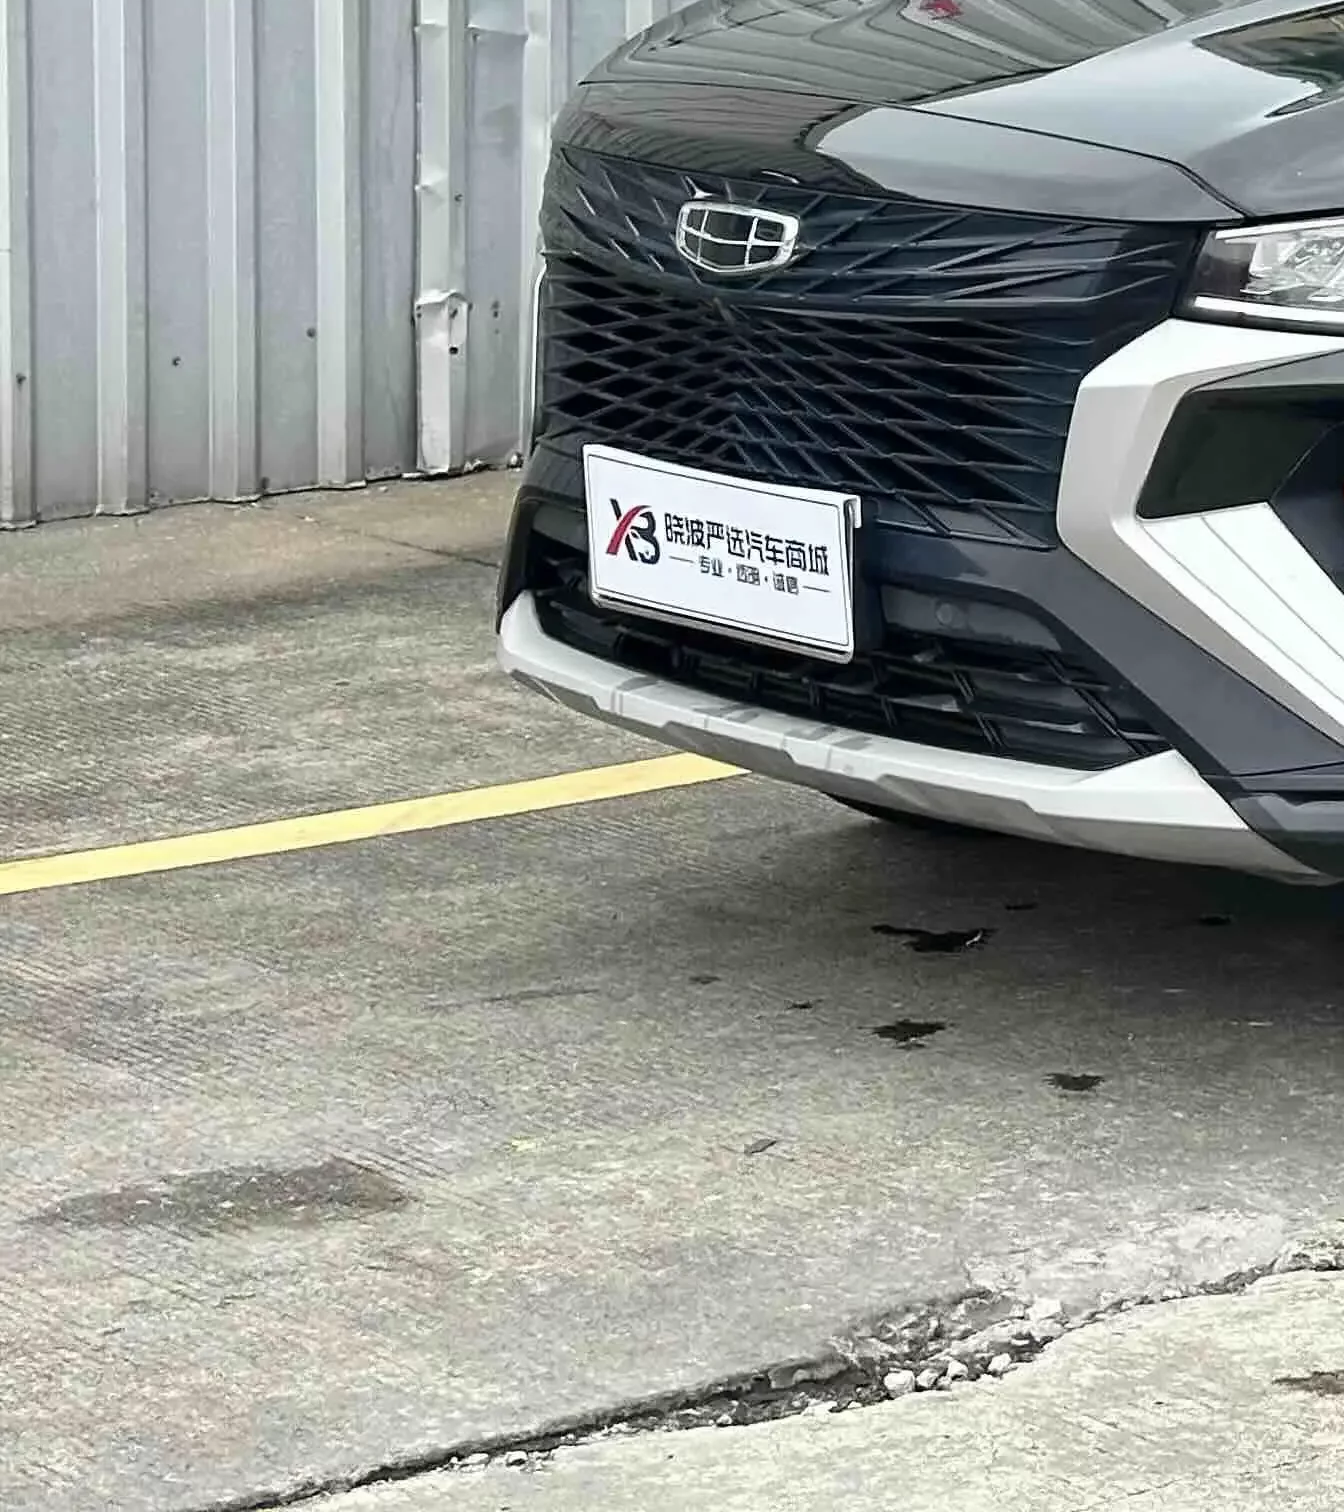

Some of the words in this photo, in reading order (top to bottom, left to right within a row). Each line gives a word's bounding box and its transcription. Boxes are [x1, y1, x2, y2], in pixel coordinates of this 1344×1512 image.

[664, 512, 830, 576] 晓波严选汽车商城
